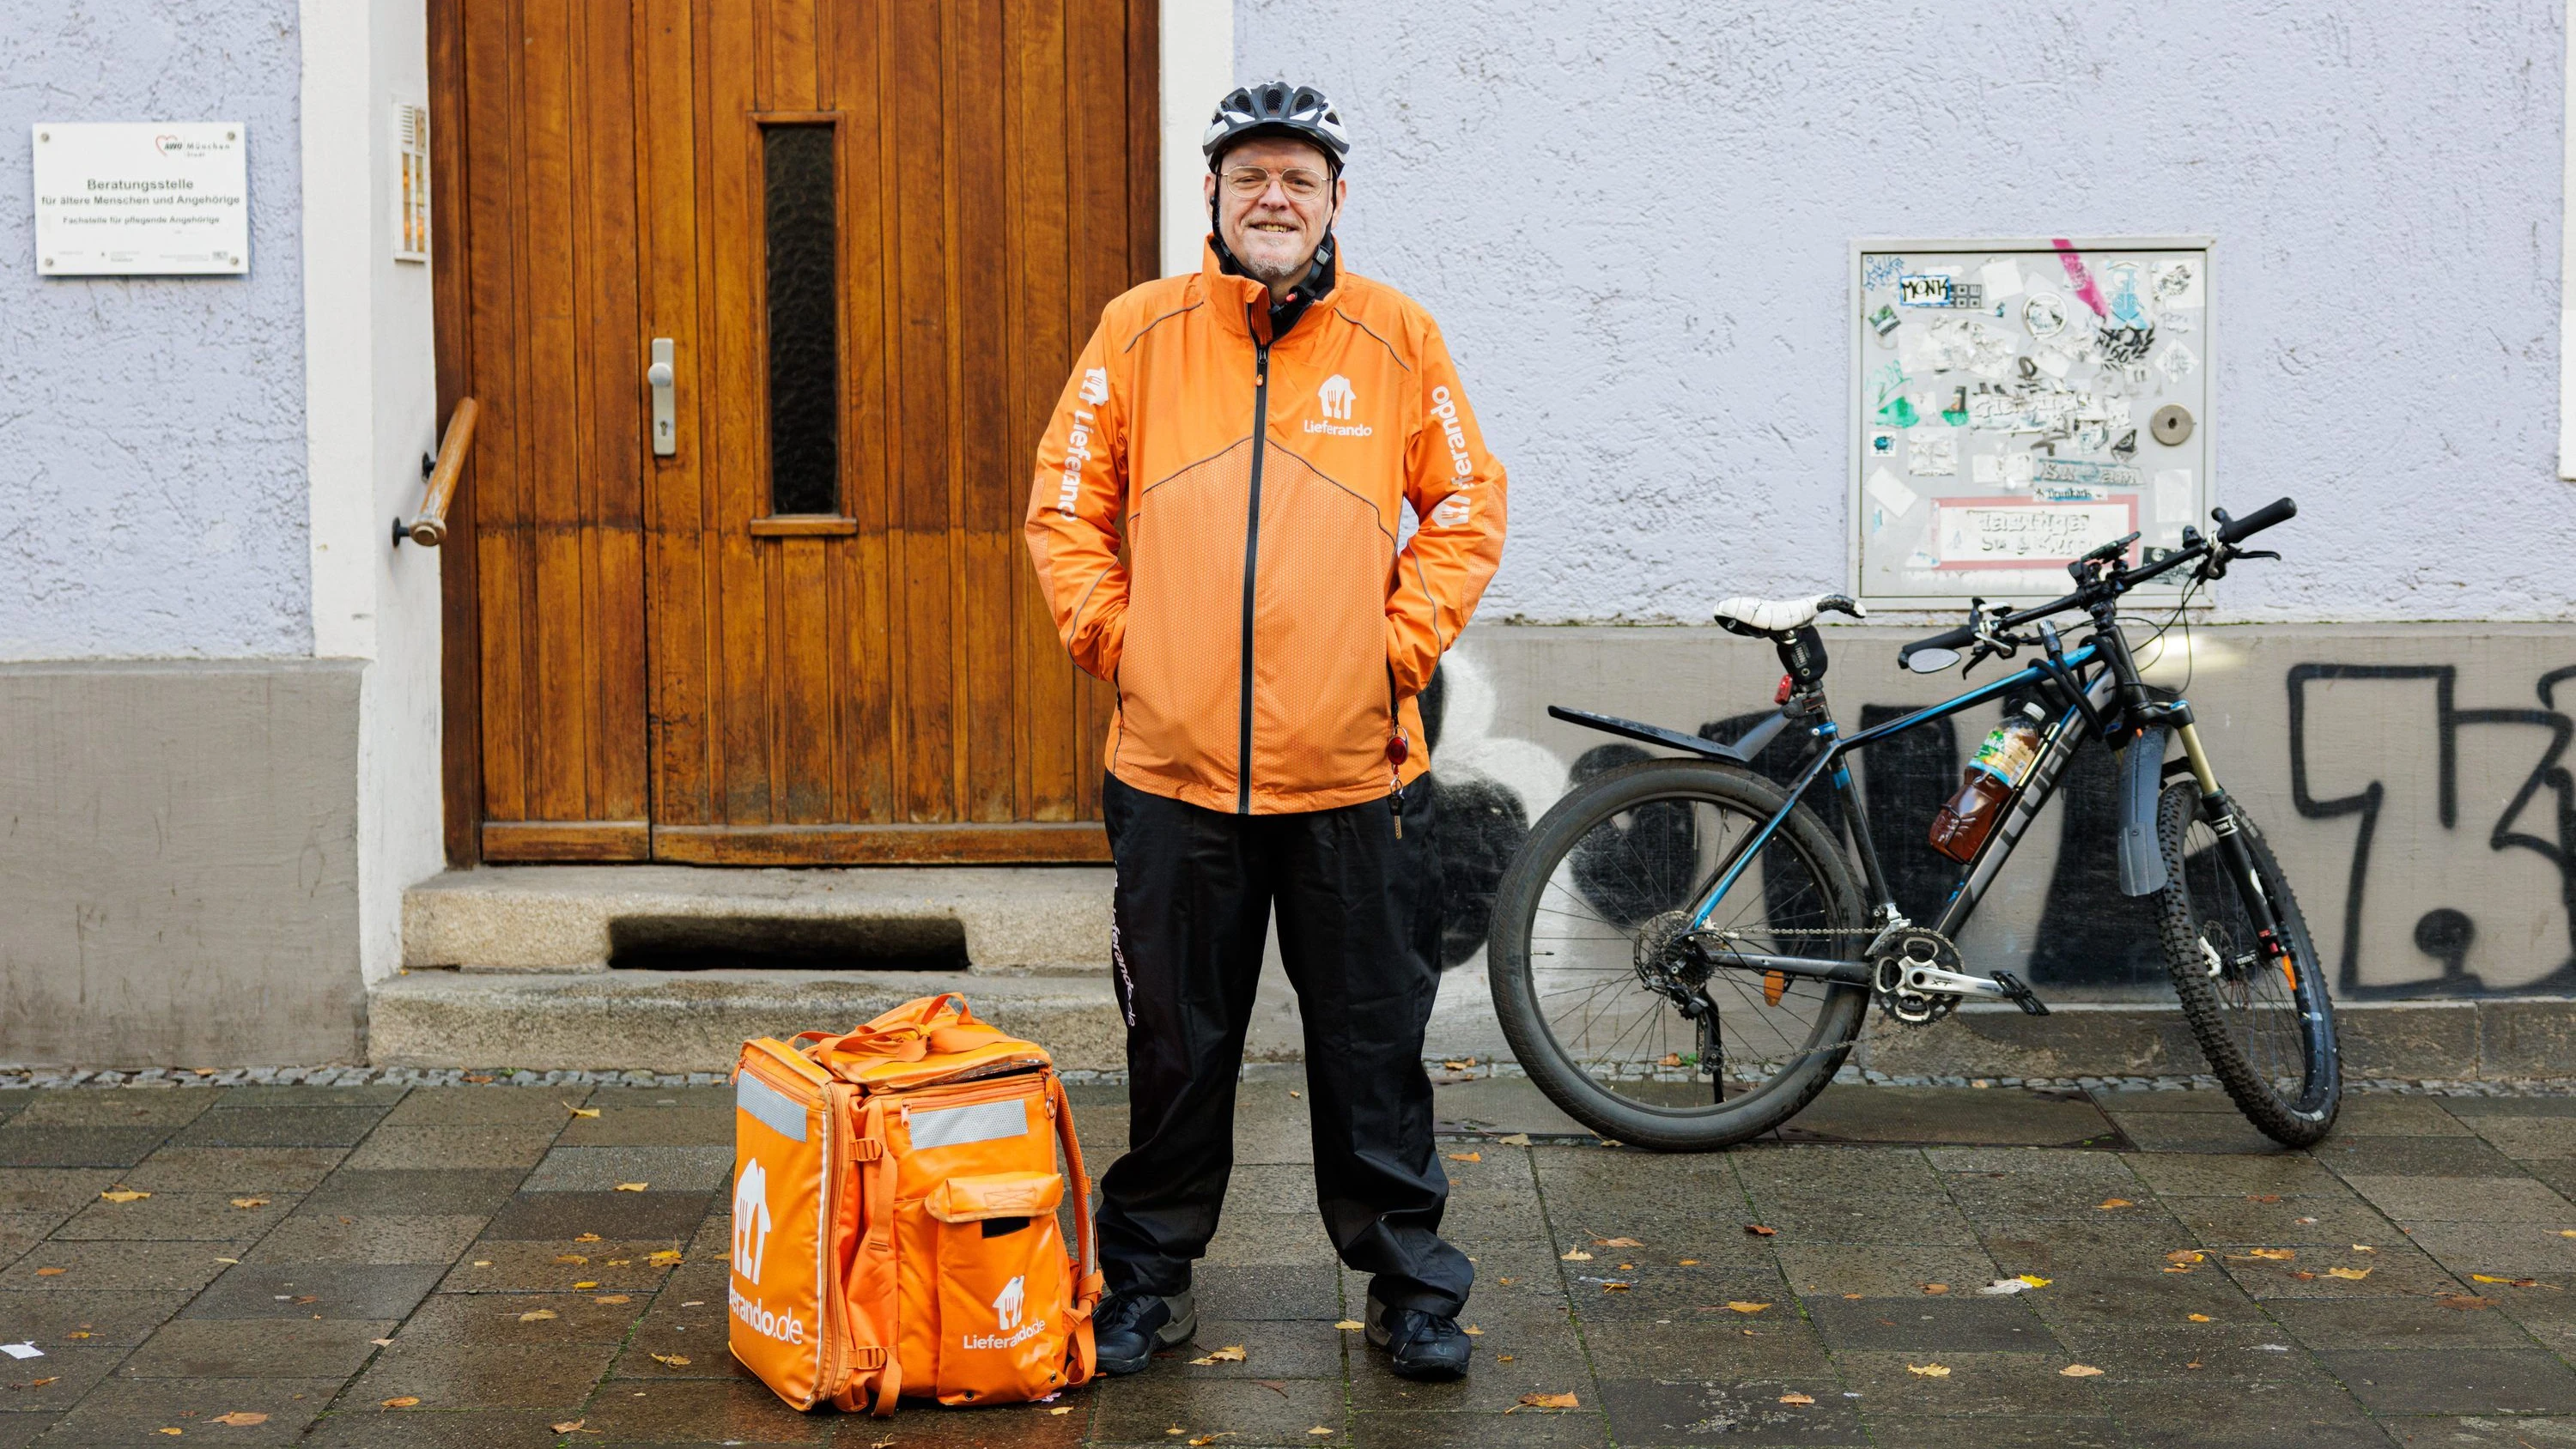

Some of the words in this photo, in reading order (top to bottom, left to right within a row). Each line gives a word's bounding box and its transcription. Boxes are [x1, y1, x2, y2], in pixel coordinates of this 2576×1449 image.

[87, 179, 193, 191] Beratungsstelle
[41, 197, 56, 205] für
[60, 197, 90, 205] ältere
[94, 196, 149, 205] Menschen
[153, 196, 174, 204] und
[177, 196, 240, 206] Angehörige
[169, 216, 220, 225] Angehörige
[1901, 278, 1949, 302] MONK
[1303, 419, 1373, 437] Lieferando
